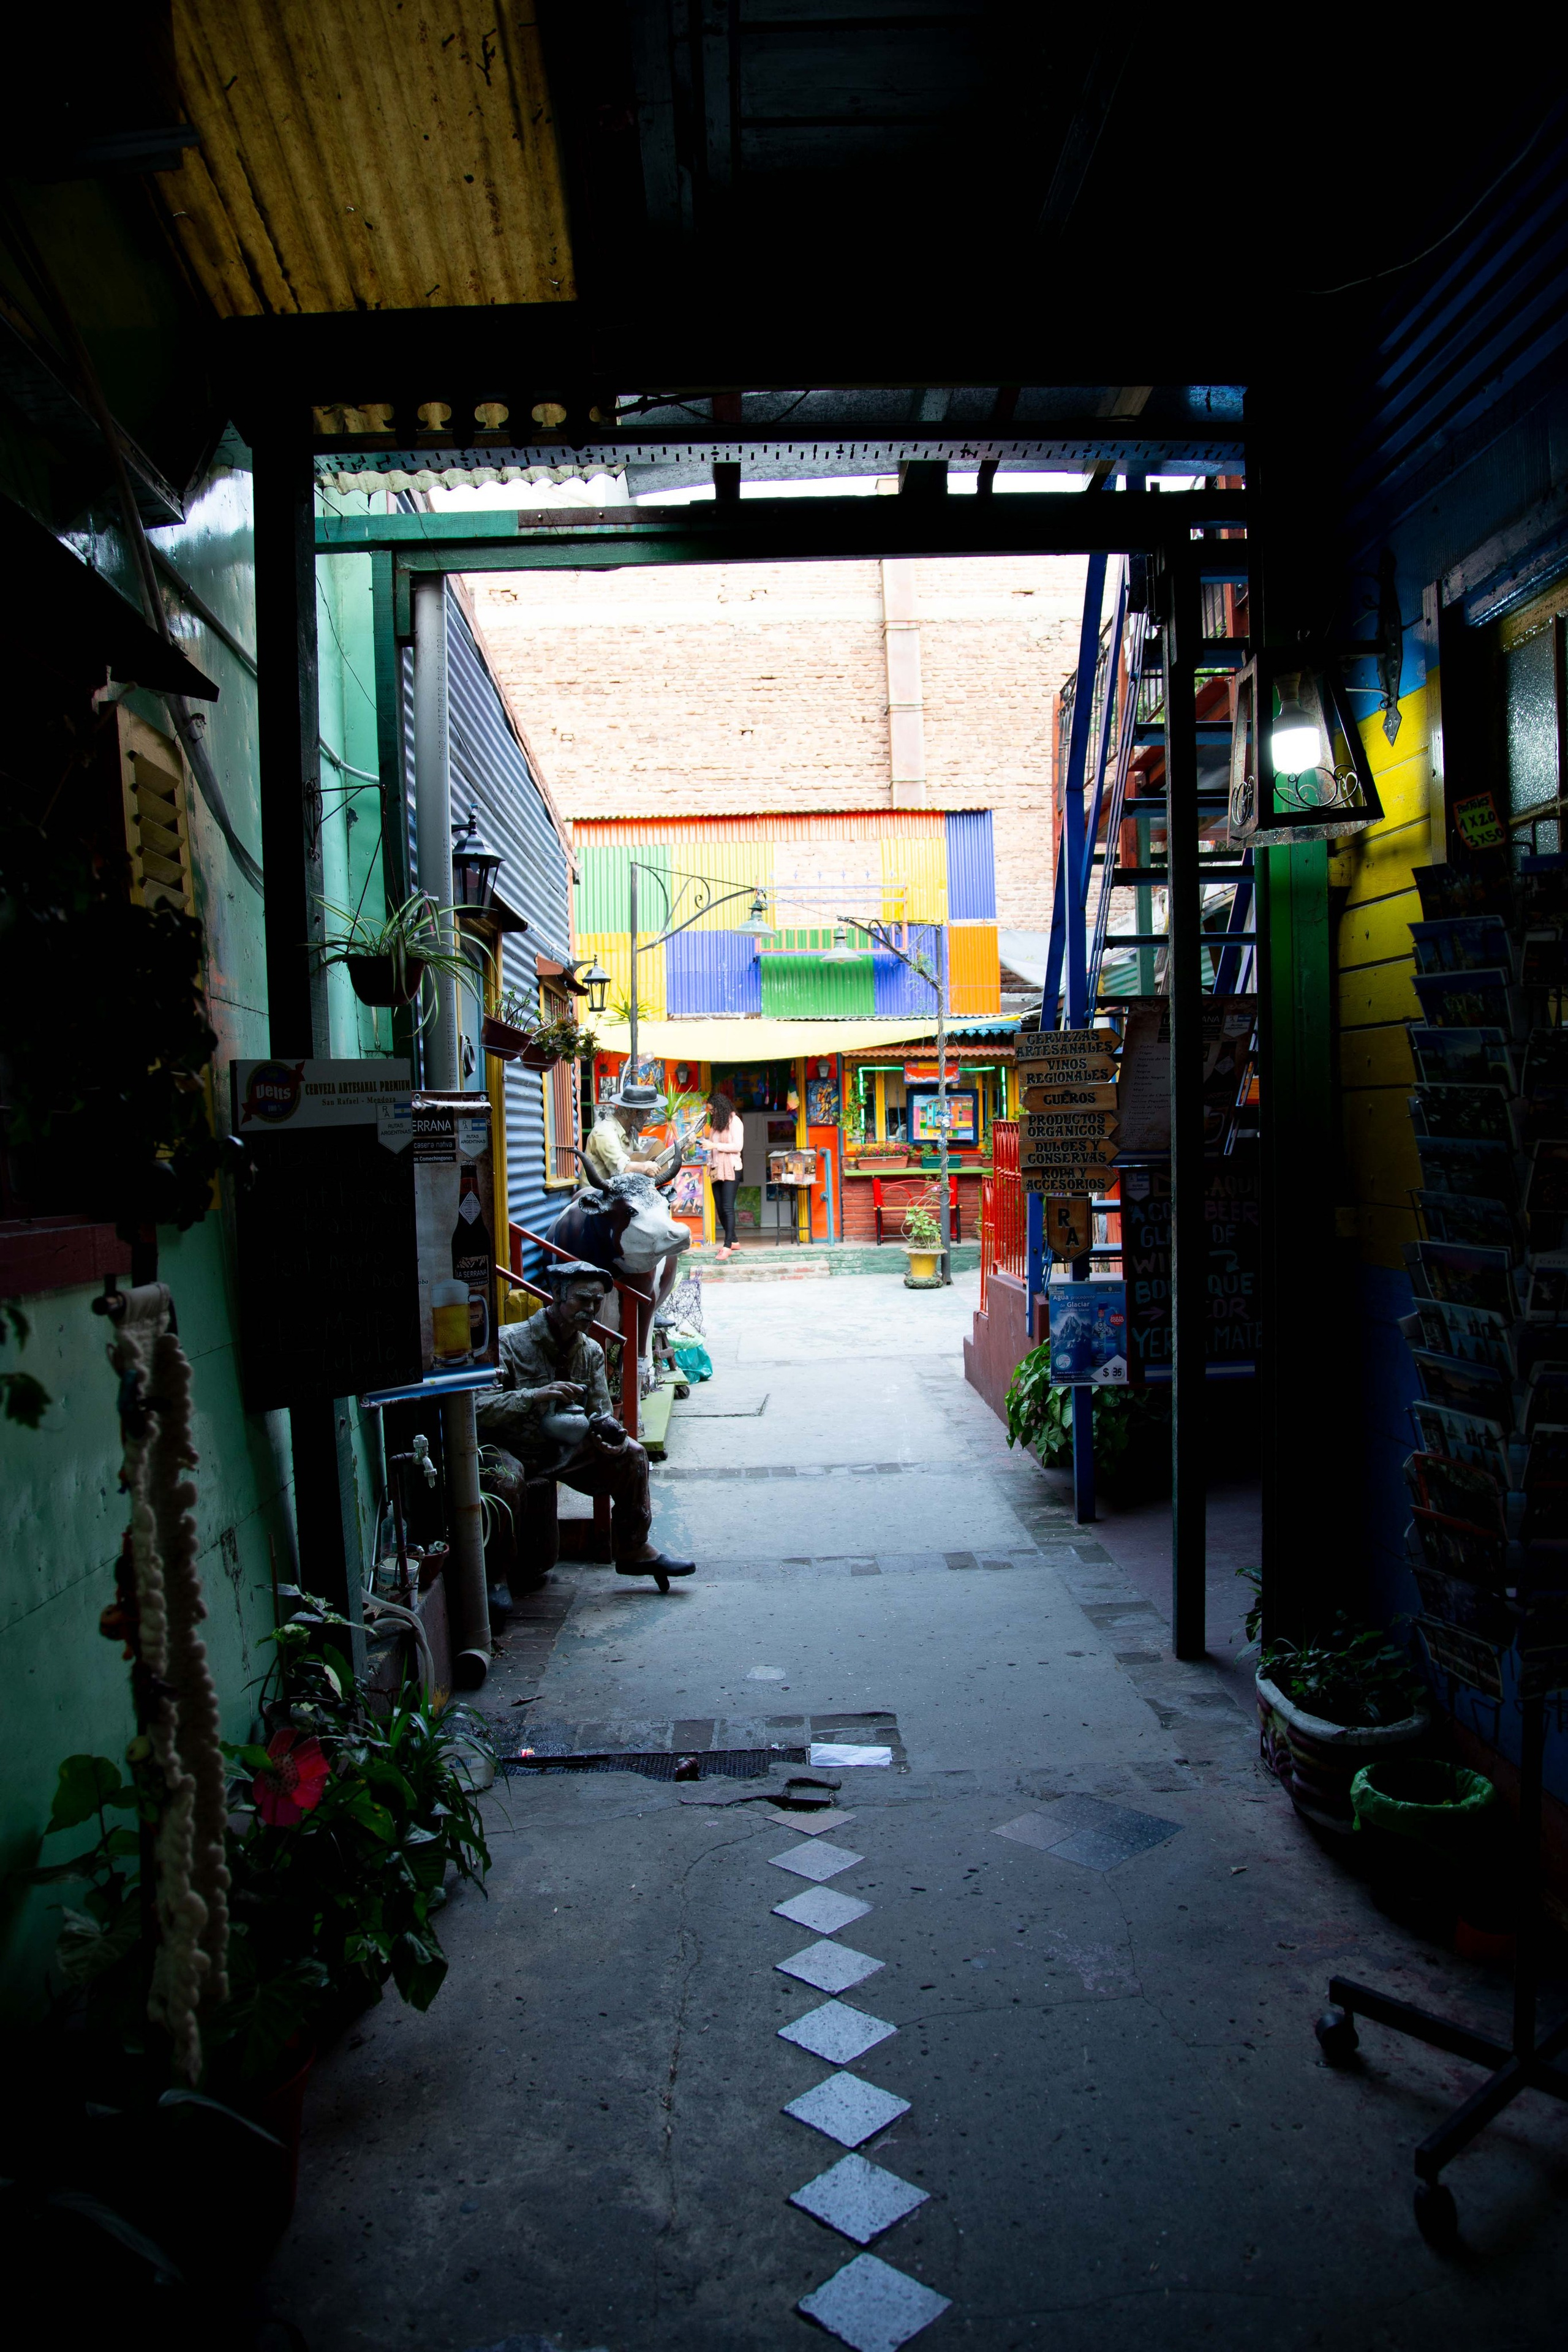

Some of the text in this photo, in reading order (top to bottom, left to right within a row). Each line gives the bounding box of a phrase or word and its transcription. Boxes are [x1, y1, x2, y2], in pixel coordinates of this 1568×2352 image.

[447, 1012, 455, 1062] ARGENTINA
[1027, 1030, 1099, 1045] CERVEZAS
[1016, 1041, 1113, 1058] ARTESANALES
[1047, 1058, 1088, 1071] VINOS
[1026, 1069, 1109, 1085] REGIONALES
[305, 1080, 410, 1095] CERVEZA ARTESANAL PREMIUM
[1043, 1091, 1096, 1106] CUEROS
[412, 1119, 452, 1133] ERRANA
[1028, 1113, 1106, 1126] PRODUCTOS
[1027, 1125, 1106, 1137] ORGANICOS
[1035, 1140, 1101, 1153] DULCES Y
[420, 1155, 453, 1164] Comechingones
[1027, 1152, 1107, 1164] CONSERVAS
[1041, 1167, 1088, 1179] ROPA Y
[1026, 1178, 1106, 1191] ACCESORIOS
[1058, 1207, 1071, 1227] R
[1065, 1226, 1080, 1247] A
[463, 1268, 488, 1278] SERRANA
